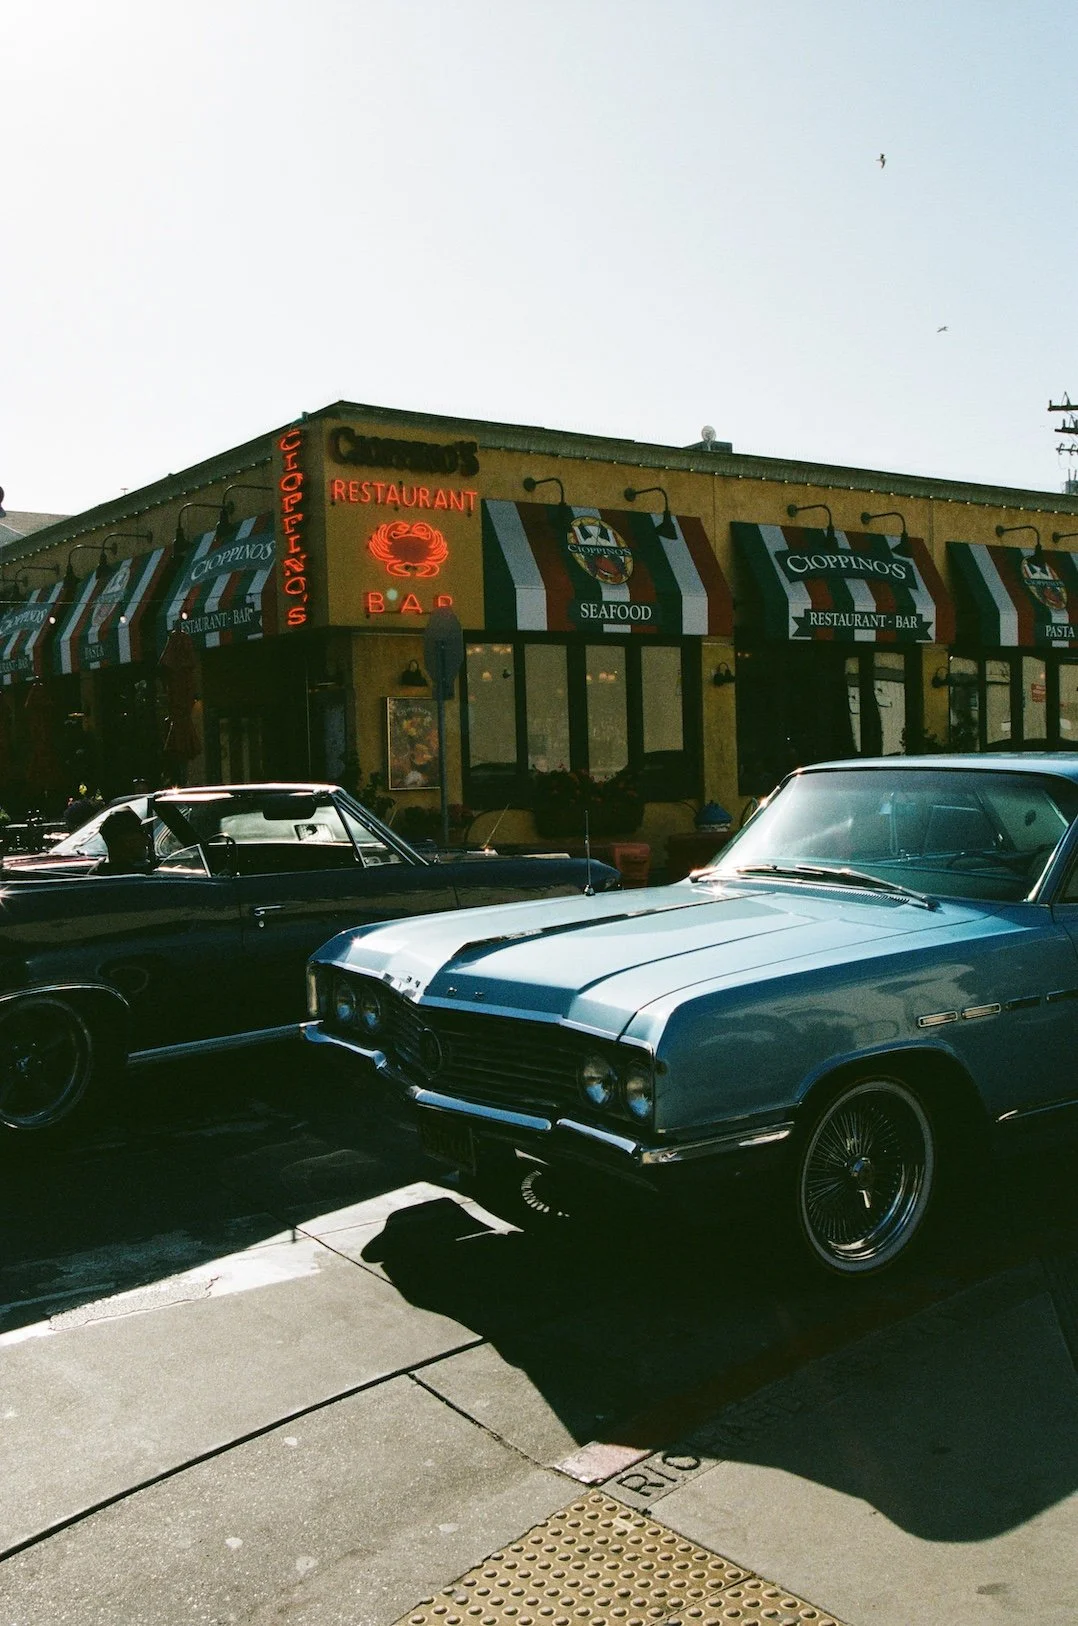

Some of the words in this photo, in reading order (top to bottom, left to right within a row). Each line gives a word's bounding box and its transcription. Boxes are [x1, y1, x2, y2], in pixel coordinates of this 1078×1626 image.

[332, 479, 478, 511] RESTAURANT
[786, 554, 907, 580] CIOPPINO'S
[580, 602, 652, 621] SEAFOOD
[809, 611, 887, 629] RESTAURANT
[895, 614, 919, 630] BAR
[181, 612, 227, 634] ESTAURANT
[1045, 624, 1075, 638] PASTA
